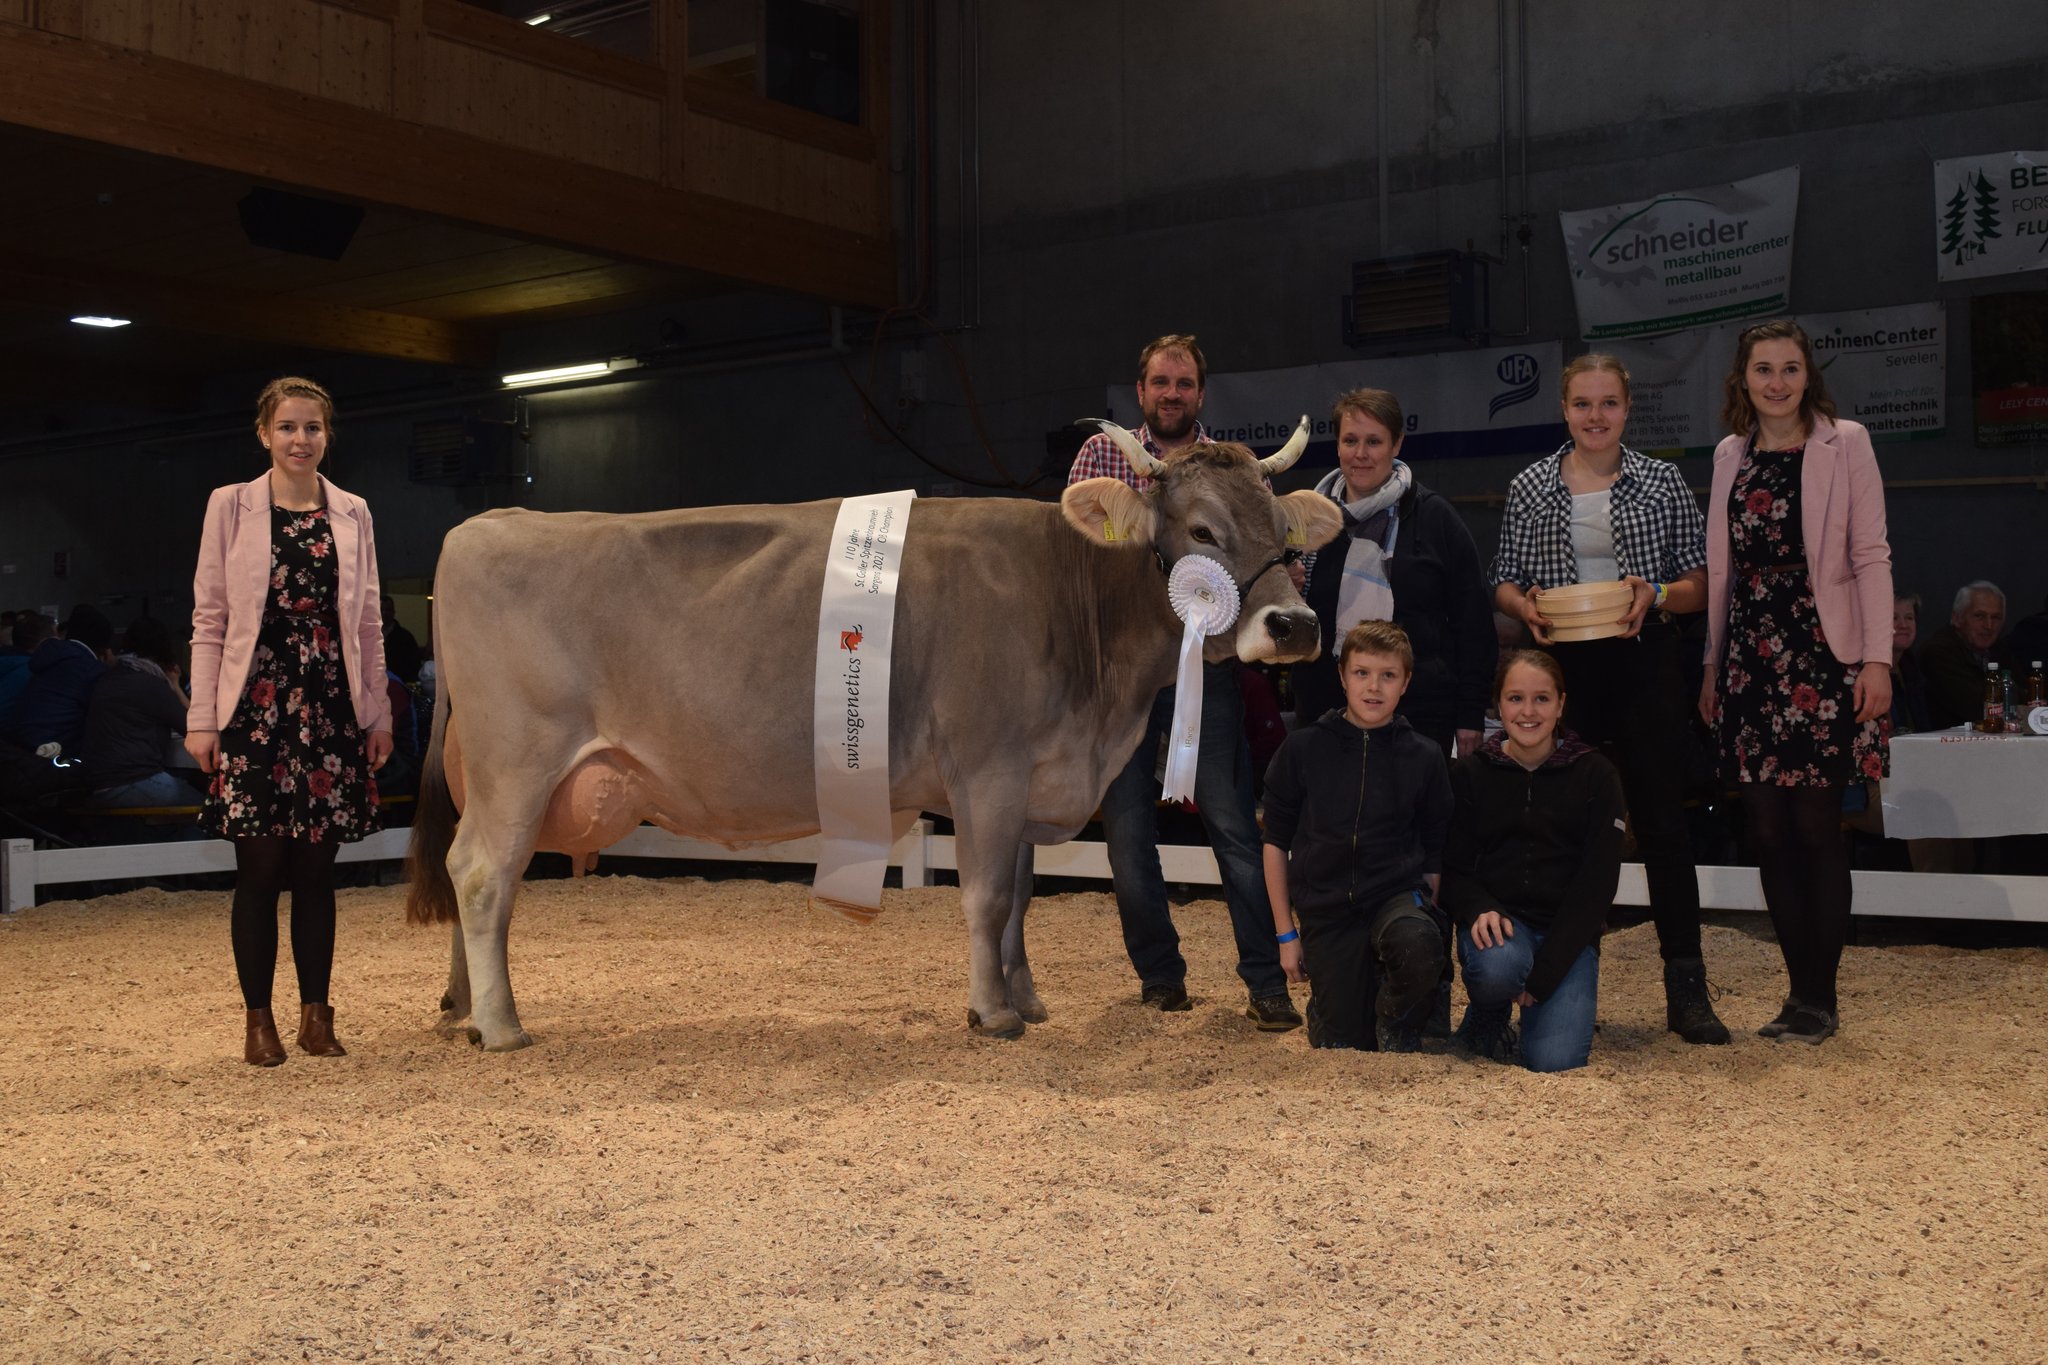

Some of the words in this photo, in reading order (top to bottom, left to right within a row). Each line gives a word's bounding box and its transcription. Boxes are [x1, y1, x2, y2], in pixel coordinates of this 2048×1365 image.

[2011, 165, 2048, 190] BE
[2012, 196, 2048, 213] FORS
[2015, 220, 2048, 236] FLU
[1607, 219, 1749, 264] schneider
[1664, 234, 1790, 270] maschinencenter
[1665, 264, 1742, 287] metallbau
[1813, 327, 1937, 349] chinenCenter
[1501, 356, 1533, 384] UFA
[1886, 352, 1938, 367] Sevelen
[1855, 398, 1938, 415] Landtechnik
[2026, 396, 2048, 408] CEN
[1206, 422, 1289, 441] lgreiche
[841, 657, 865, 770] swissgenetics
